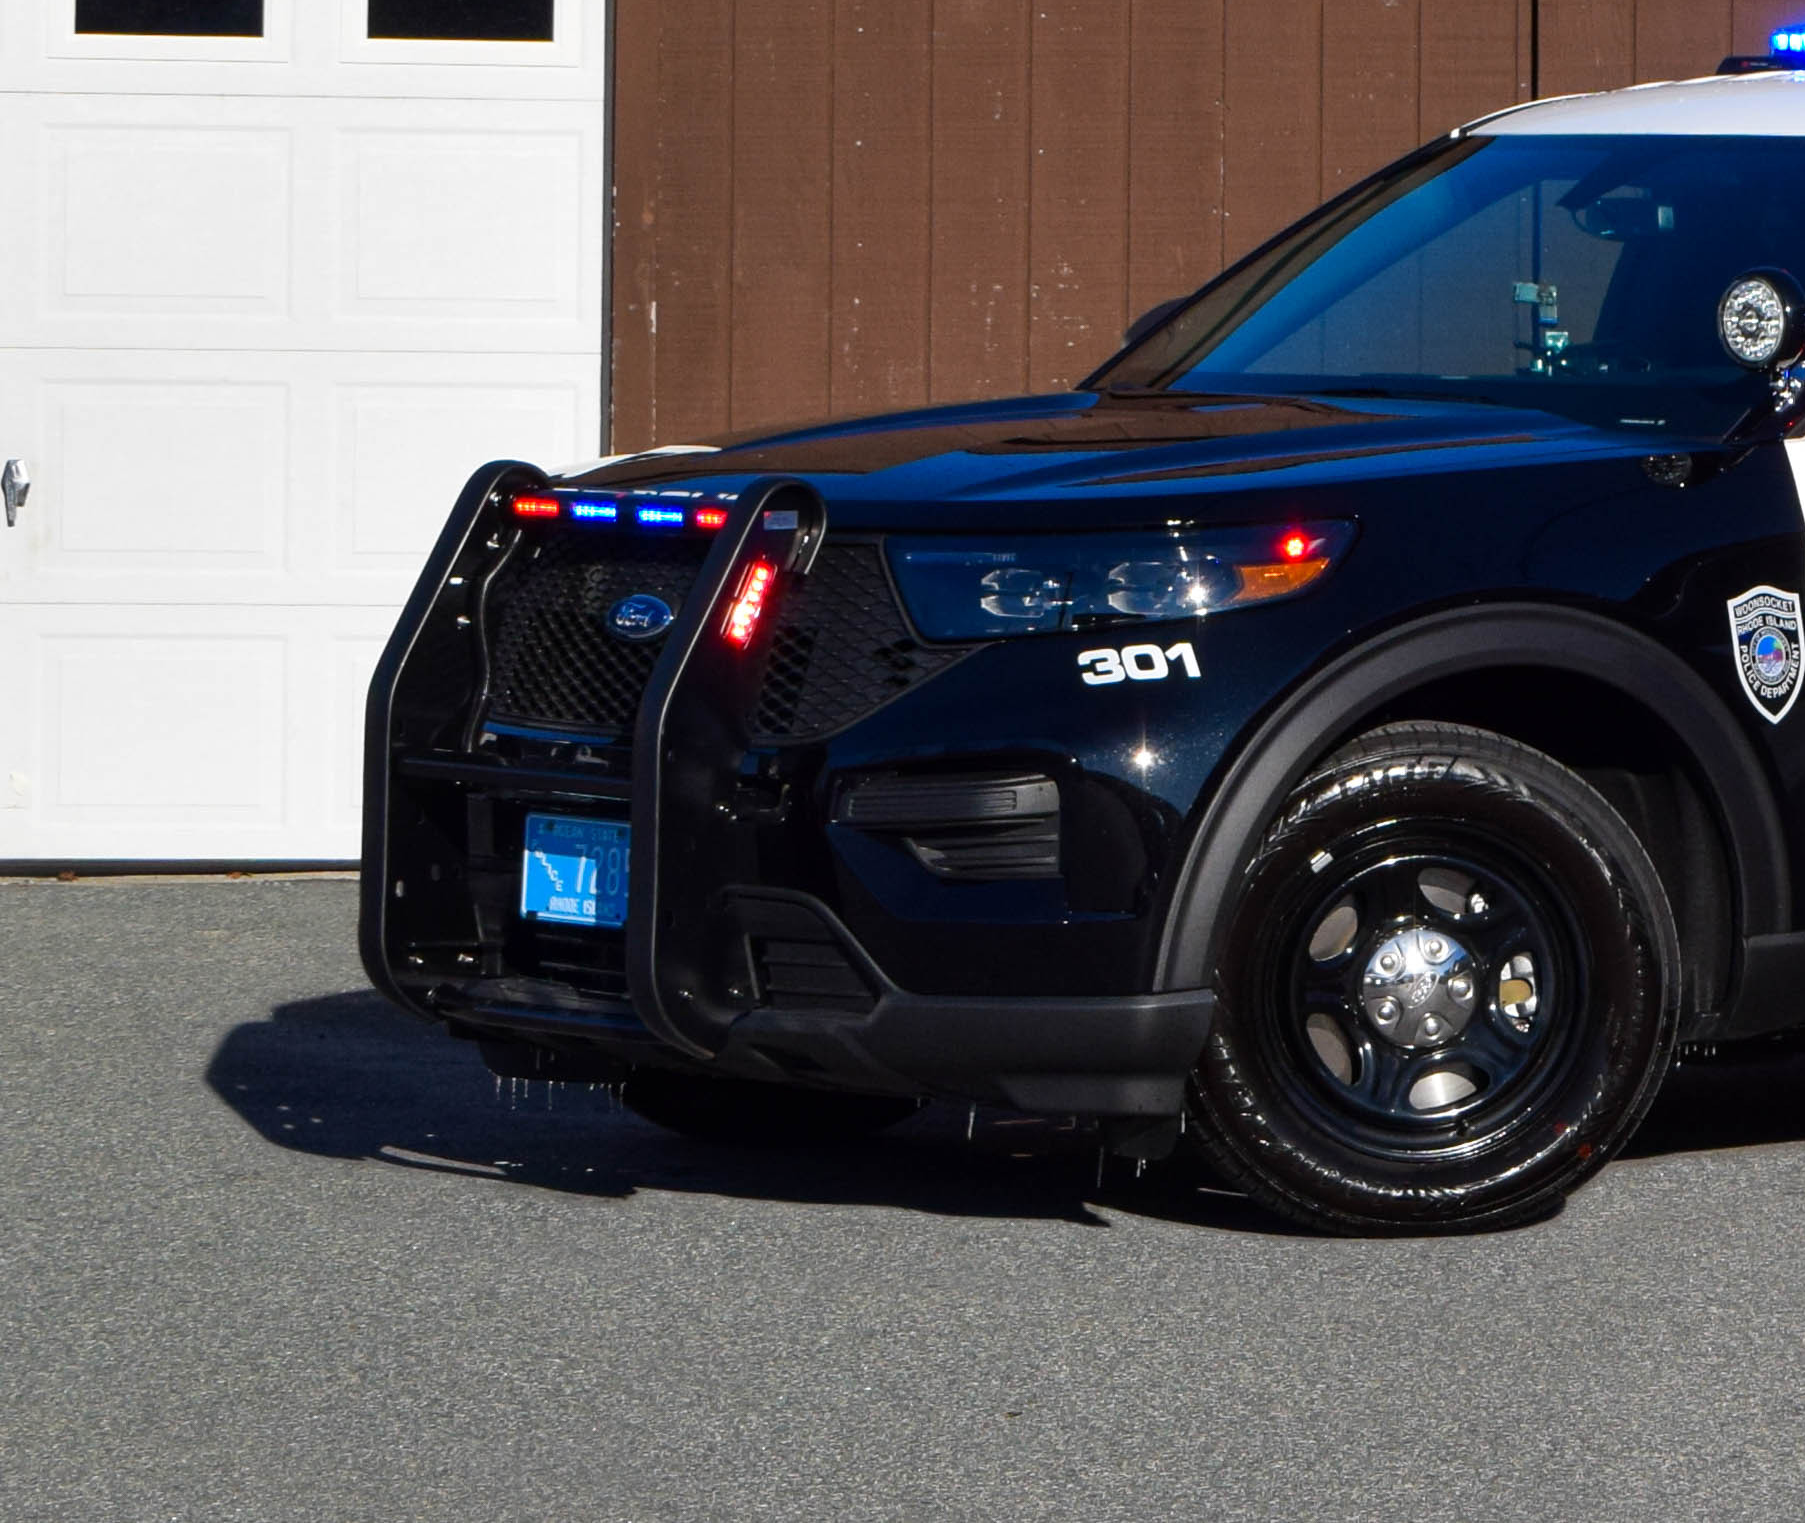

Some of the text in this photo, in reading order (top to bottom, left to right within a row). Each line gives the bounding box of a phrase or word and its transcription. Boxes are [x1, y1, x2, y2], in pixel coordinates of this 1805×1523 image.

[1734, 595, 1794, 617] WOONSOCKET
[1737, 616, 1797, 636] RHODE ISLAND
[1077, 642, 1201, 685] 301
[1740, 644, 1762, 691] POLICE
[1760, 641, 1801, 699] DEPARTMENT
